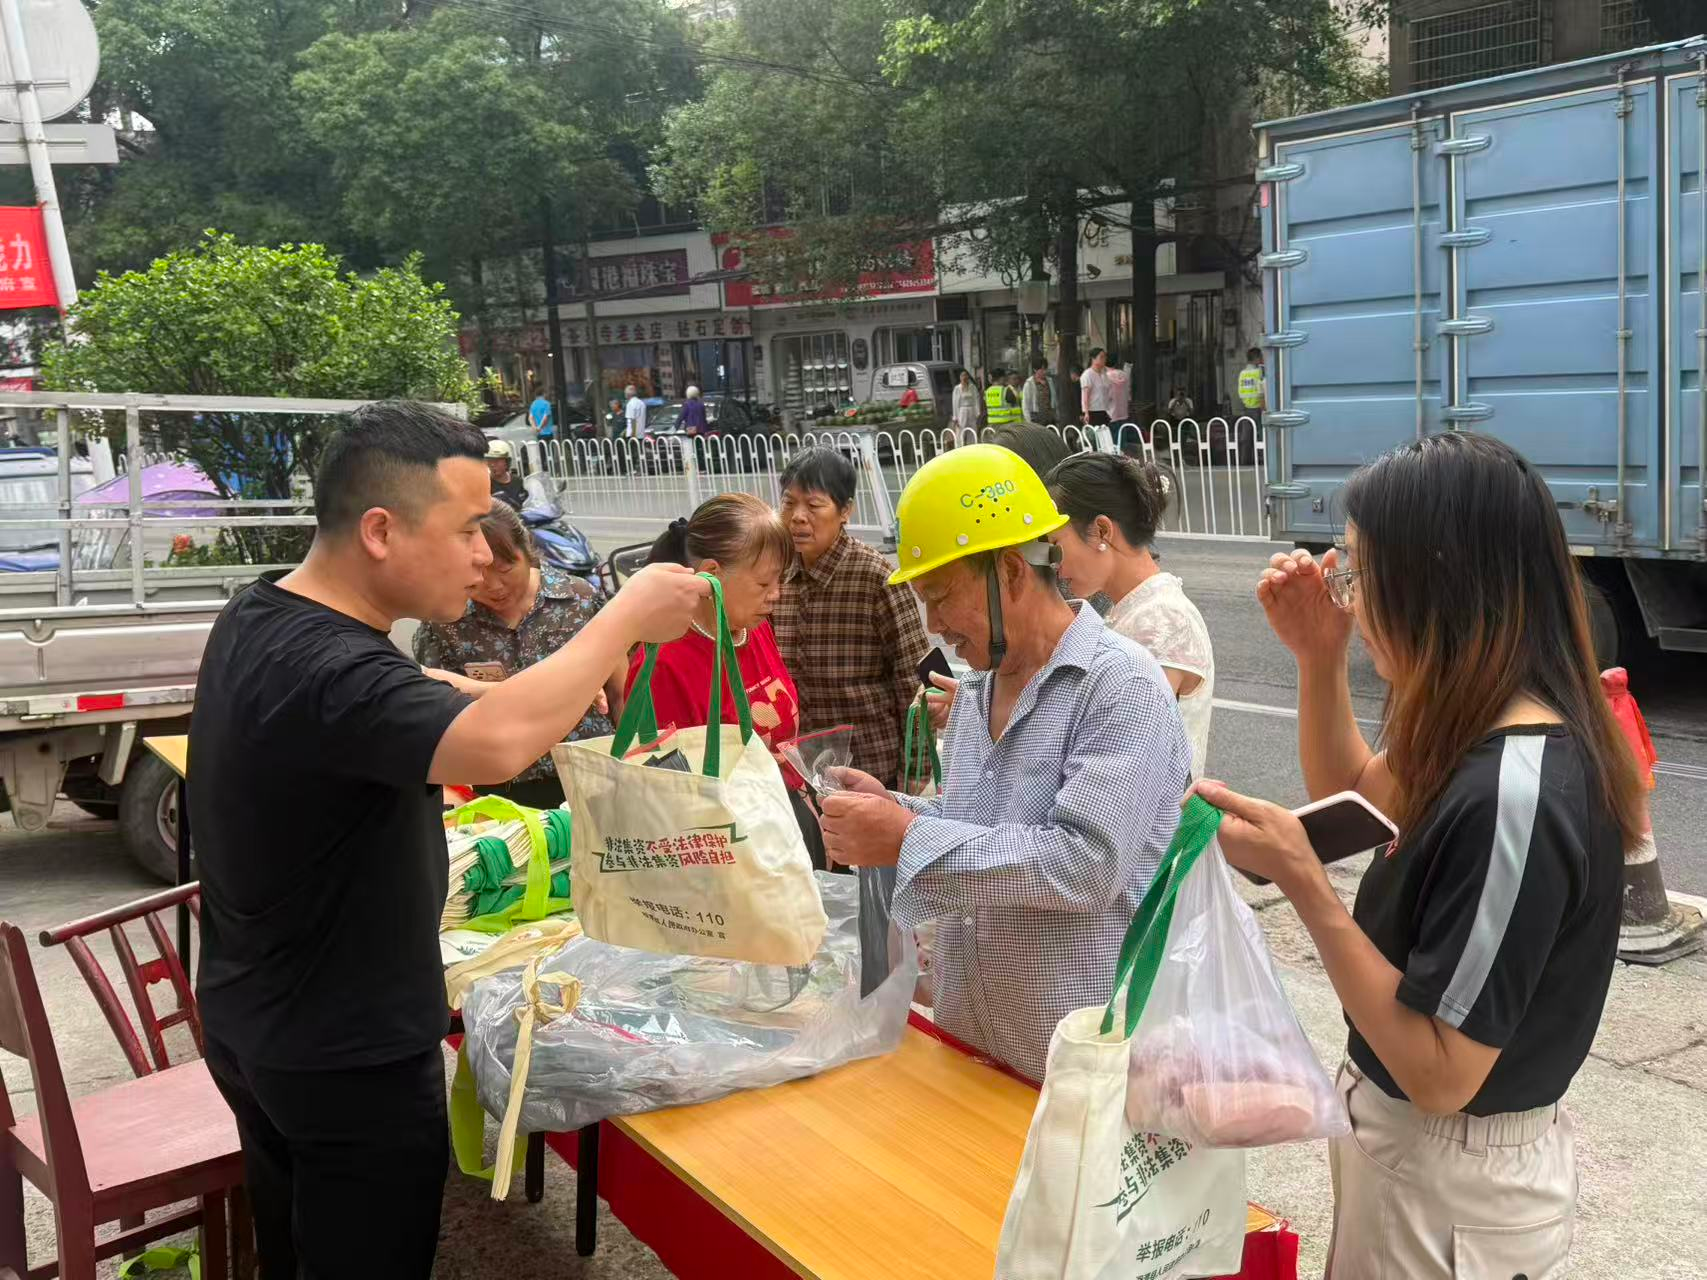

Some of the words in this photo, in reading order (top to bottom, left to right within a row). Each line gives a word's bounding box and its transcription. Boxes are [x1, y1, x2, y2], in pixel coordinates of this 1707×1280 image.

[604, 833, 728, 855] 非法集资不受法律保护
[605, 849, 736, 869] 参与非法集资风险自担
[1118, 1137, 1192, 1208] 参与非法集资
